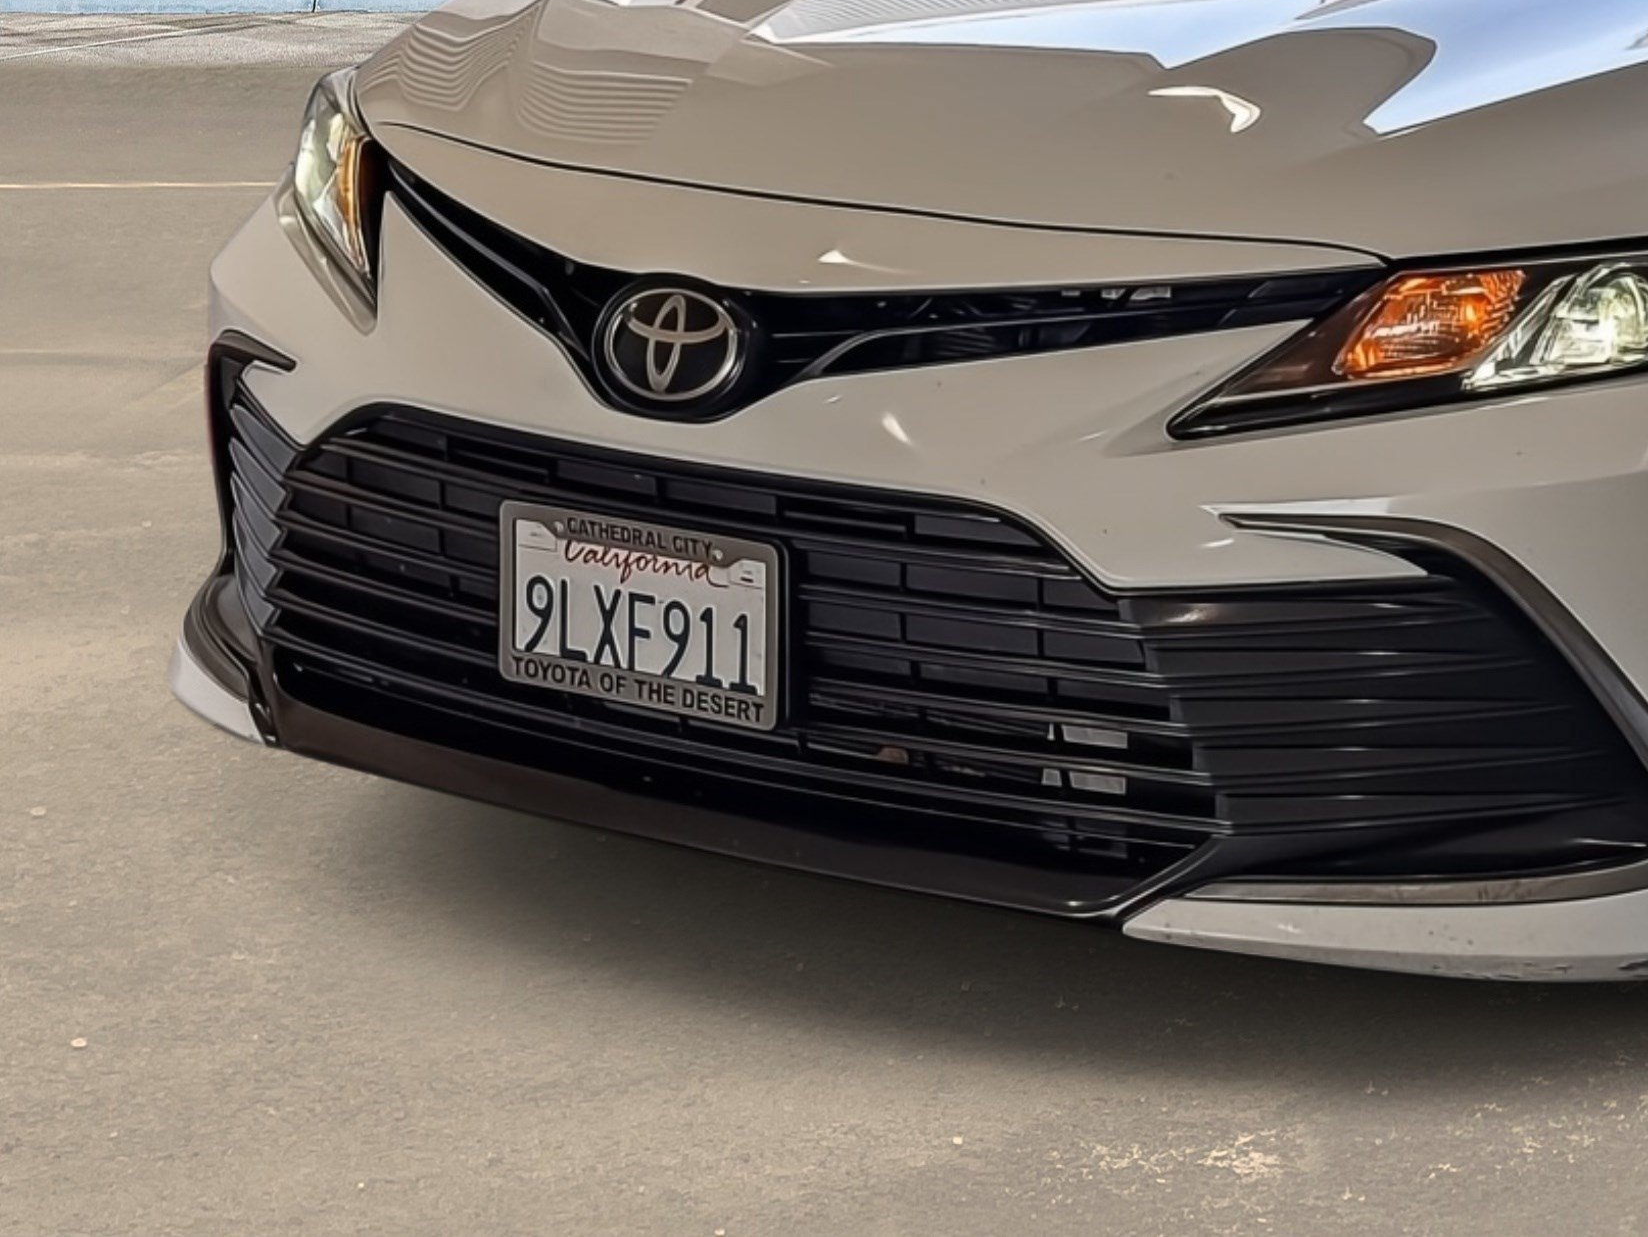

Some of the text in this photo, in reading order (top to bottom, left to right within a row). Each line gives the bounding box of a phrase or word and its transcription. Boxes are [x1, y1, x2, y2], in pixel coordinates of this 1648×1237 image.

[564, 540, 728, 586] California
[566, 517, 713, 559] CATHEDRAL CITY
[525, 575, 757, 695] 9LXF911
[512, 656, 765, 723] TOYOTA OF THE DESERT
